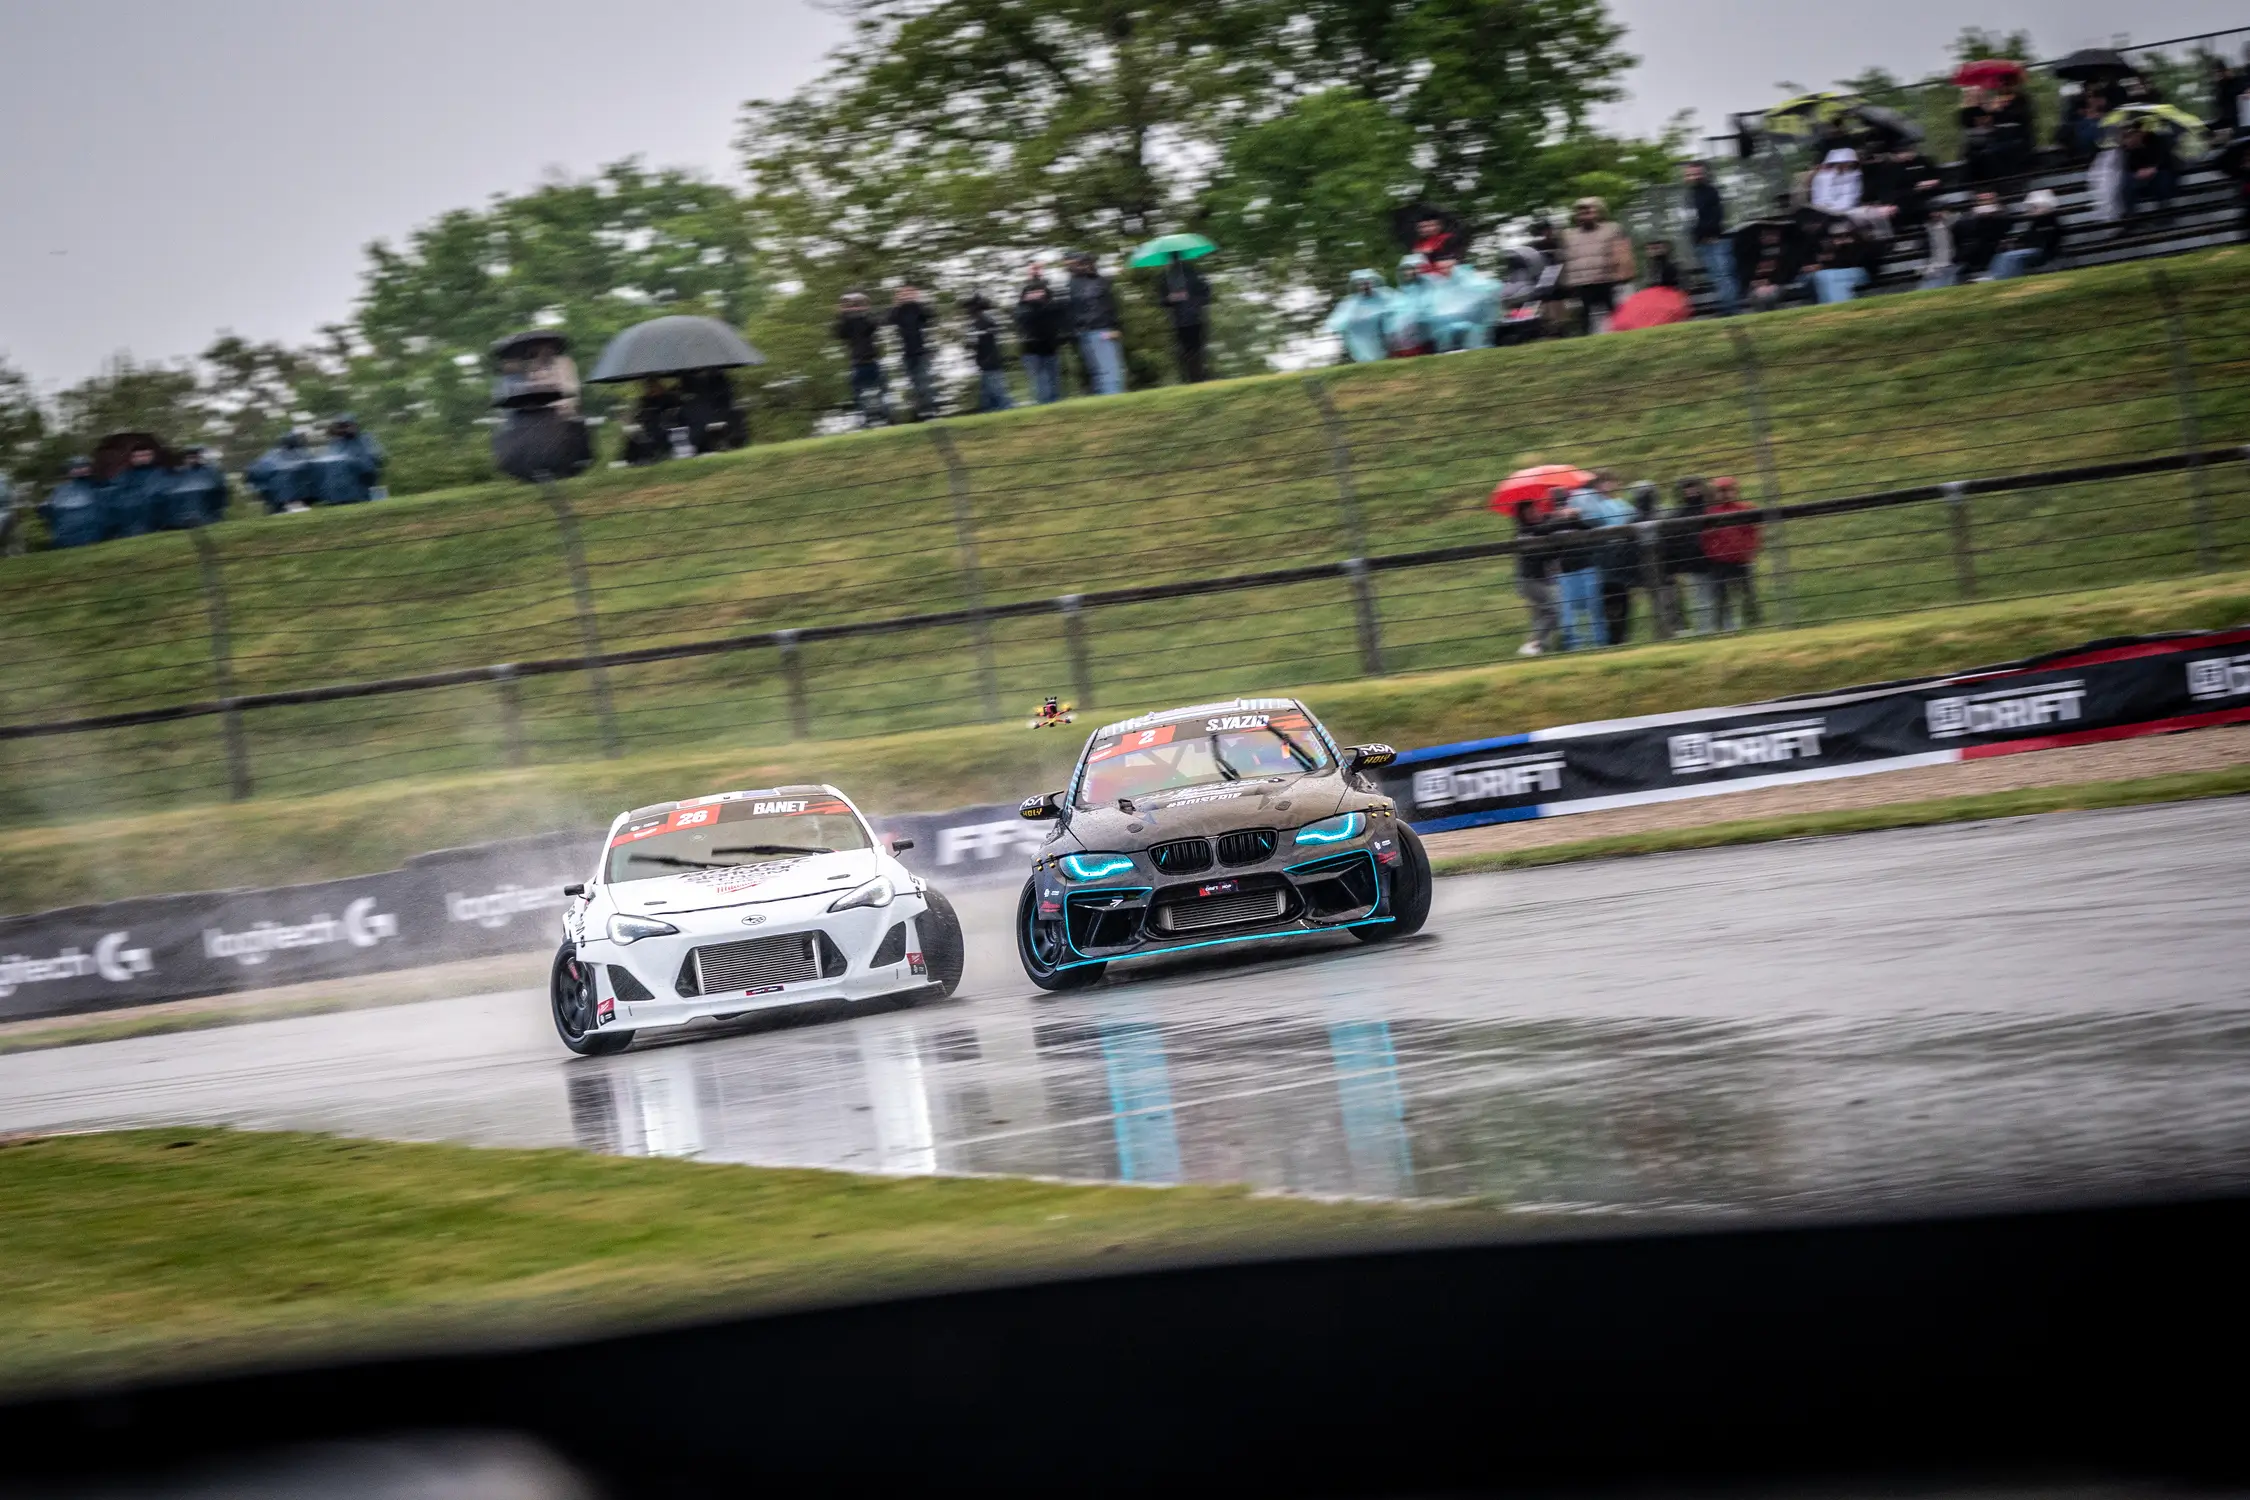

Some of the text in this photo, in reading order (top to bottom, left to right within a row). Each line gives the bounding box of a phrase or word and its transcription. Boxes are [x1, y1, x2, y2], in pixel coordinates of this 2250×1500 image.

[1965, 690, 2087, 734] DRIFT
[1205, 714, 1269, 732] S.YAZID
[1138, 730, 1156, 745] 2
[1706, 727, 1827, 770] DRIFT
[1452, 760, 1568, 804] DRIFT
[753, 801, 808, 815] BANET
[676, 809, 708, 827] 26
